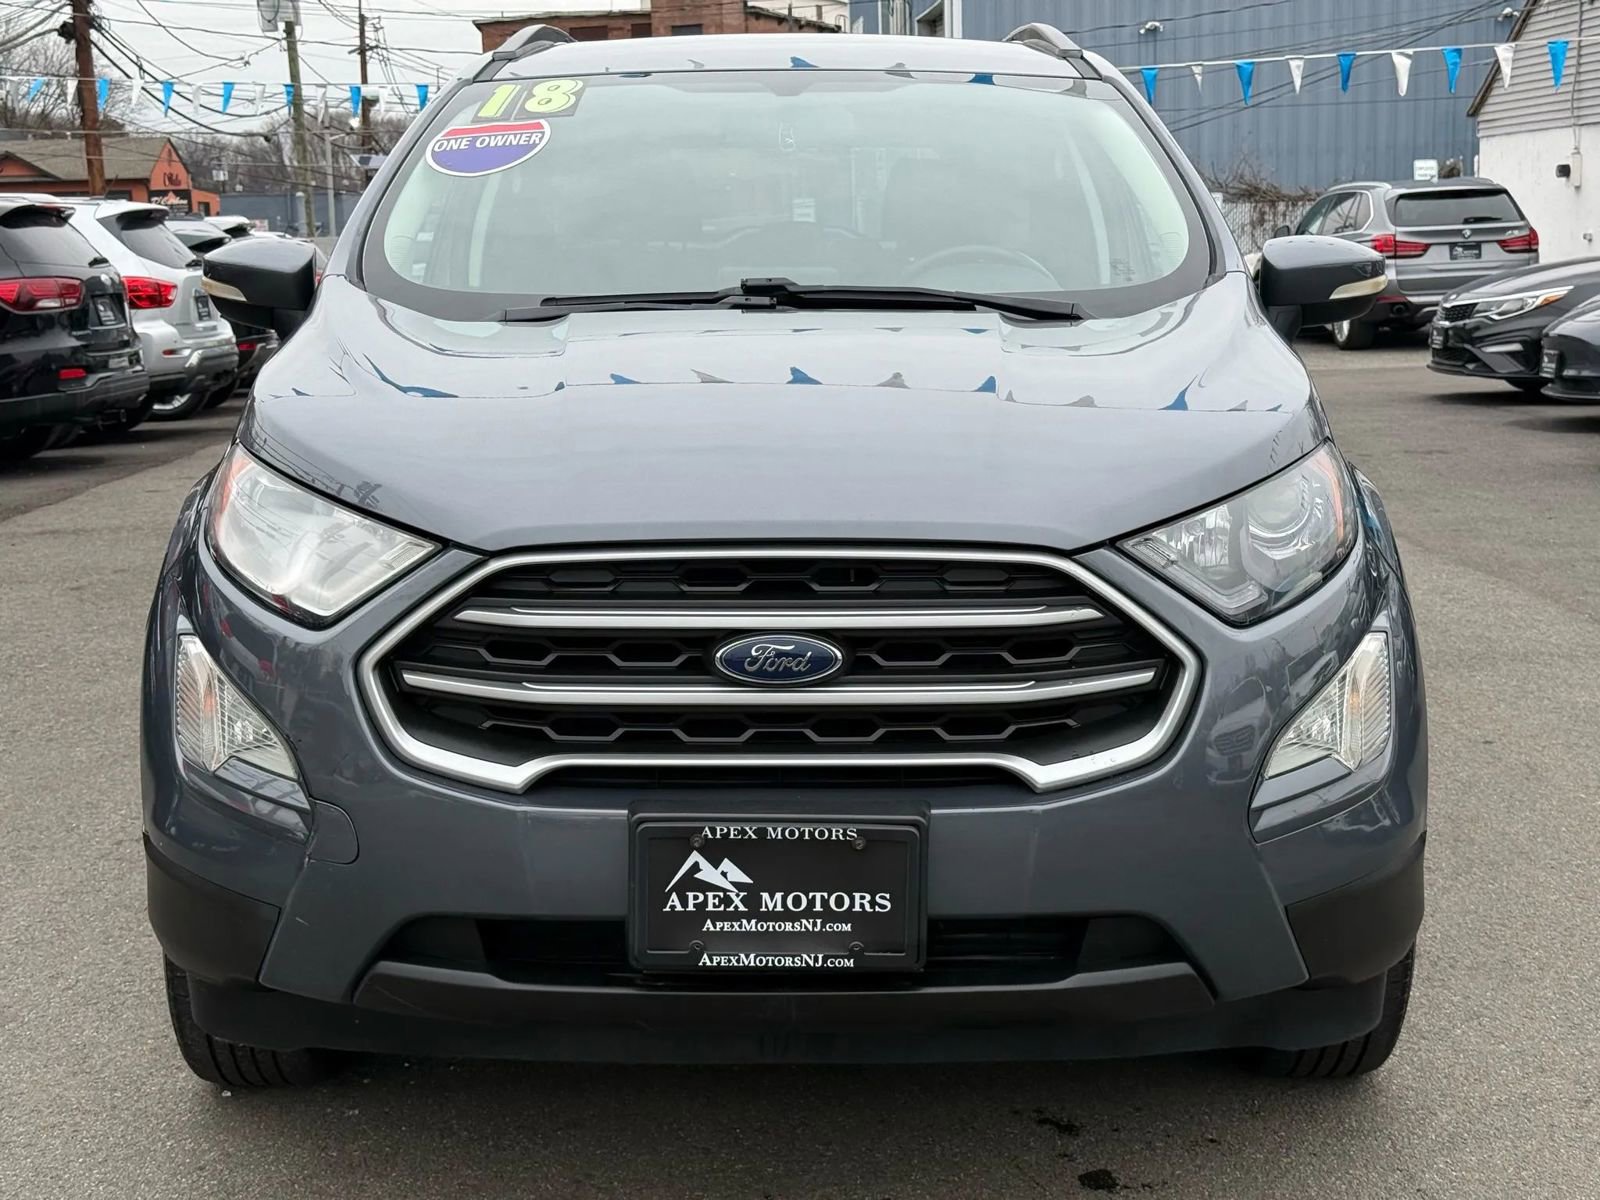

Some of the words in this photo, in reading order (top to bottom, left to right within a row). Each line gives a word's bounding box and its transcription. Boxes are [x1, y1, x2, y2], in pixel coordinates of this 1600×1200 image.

[477, 79, 584, 117] 18
[434, 137, 472, 152] ONE
[476, 133, 543, 148] OWNER
[744, 643, 812, 672] Ford
[702, 826, 758, 839] APEX
[767, 827, 857, 840] MOTORS
[663, 892, 747, 912] APEX
[760, 892, 891, 912] MOTORS
